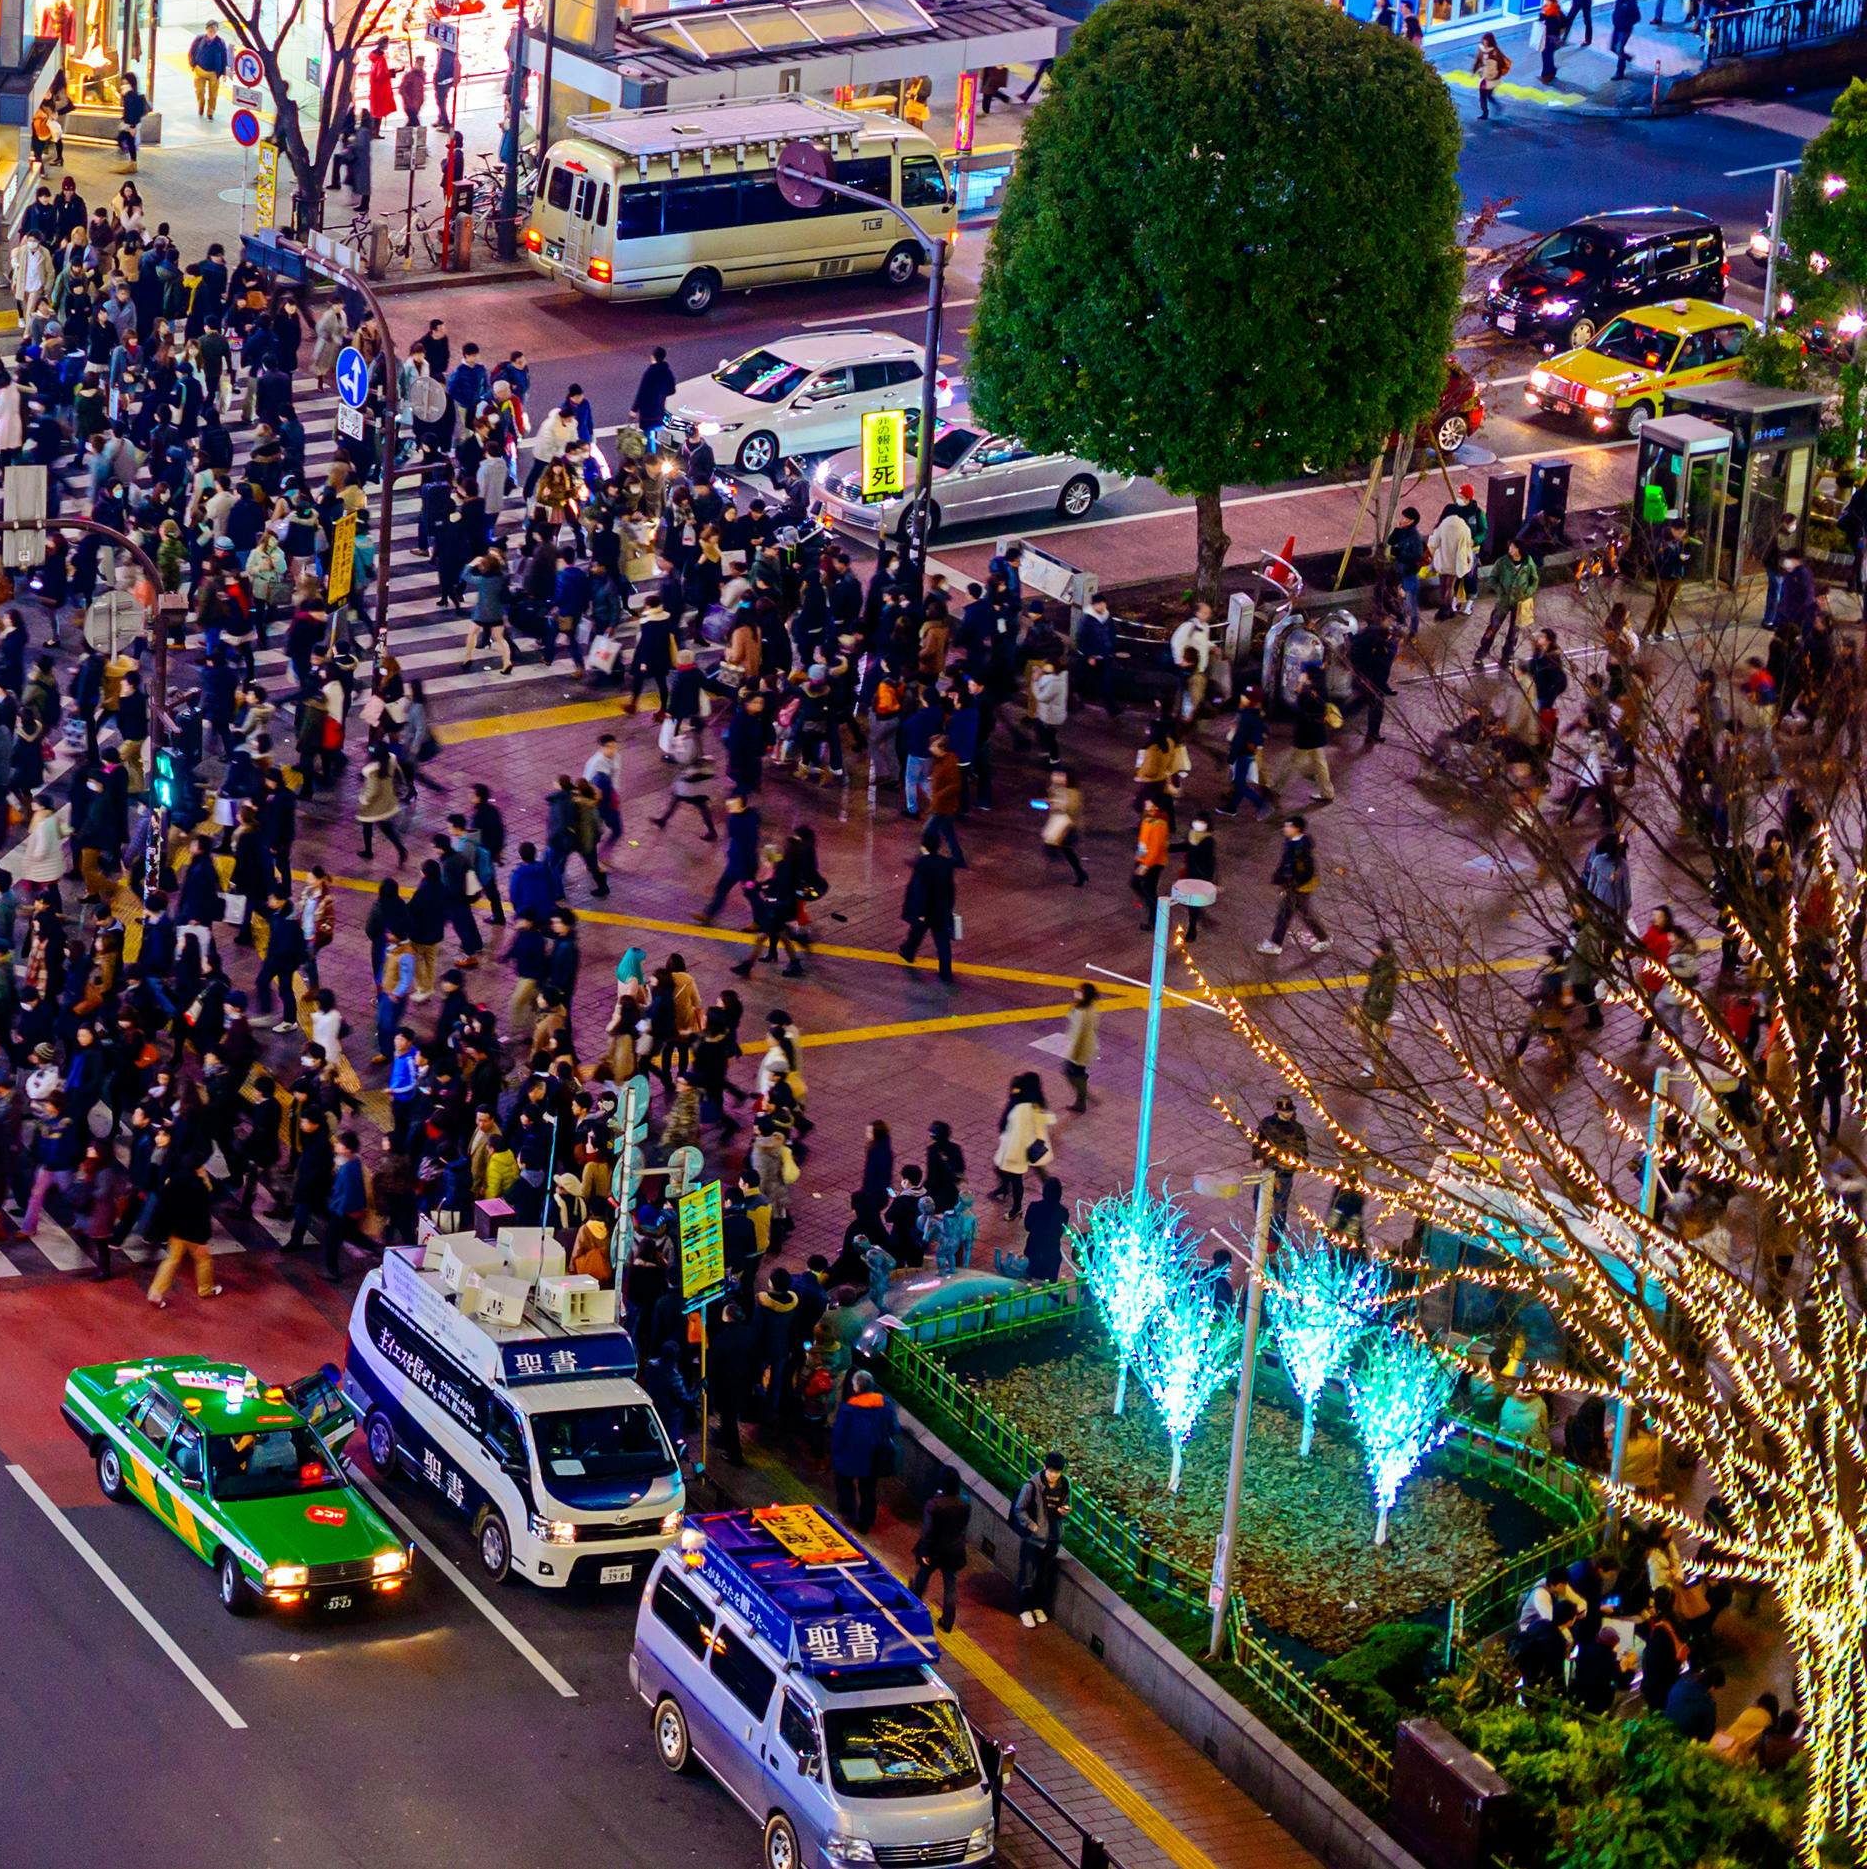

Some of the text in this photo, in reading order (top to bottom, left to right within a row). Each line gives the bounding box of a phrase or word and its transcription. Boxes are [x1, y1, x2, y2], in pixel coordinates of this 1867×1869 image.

[872, 465, 895, 487] 死
[515, 1349, 578, 1375] 聖書
[423, 1446, 466, 1507] 聖書
[805, 1622, 880, 1661] 聖書
